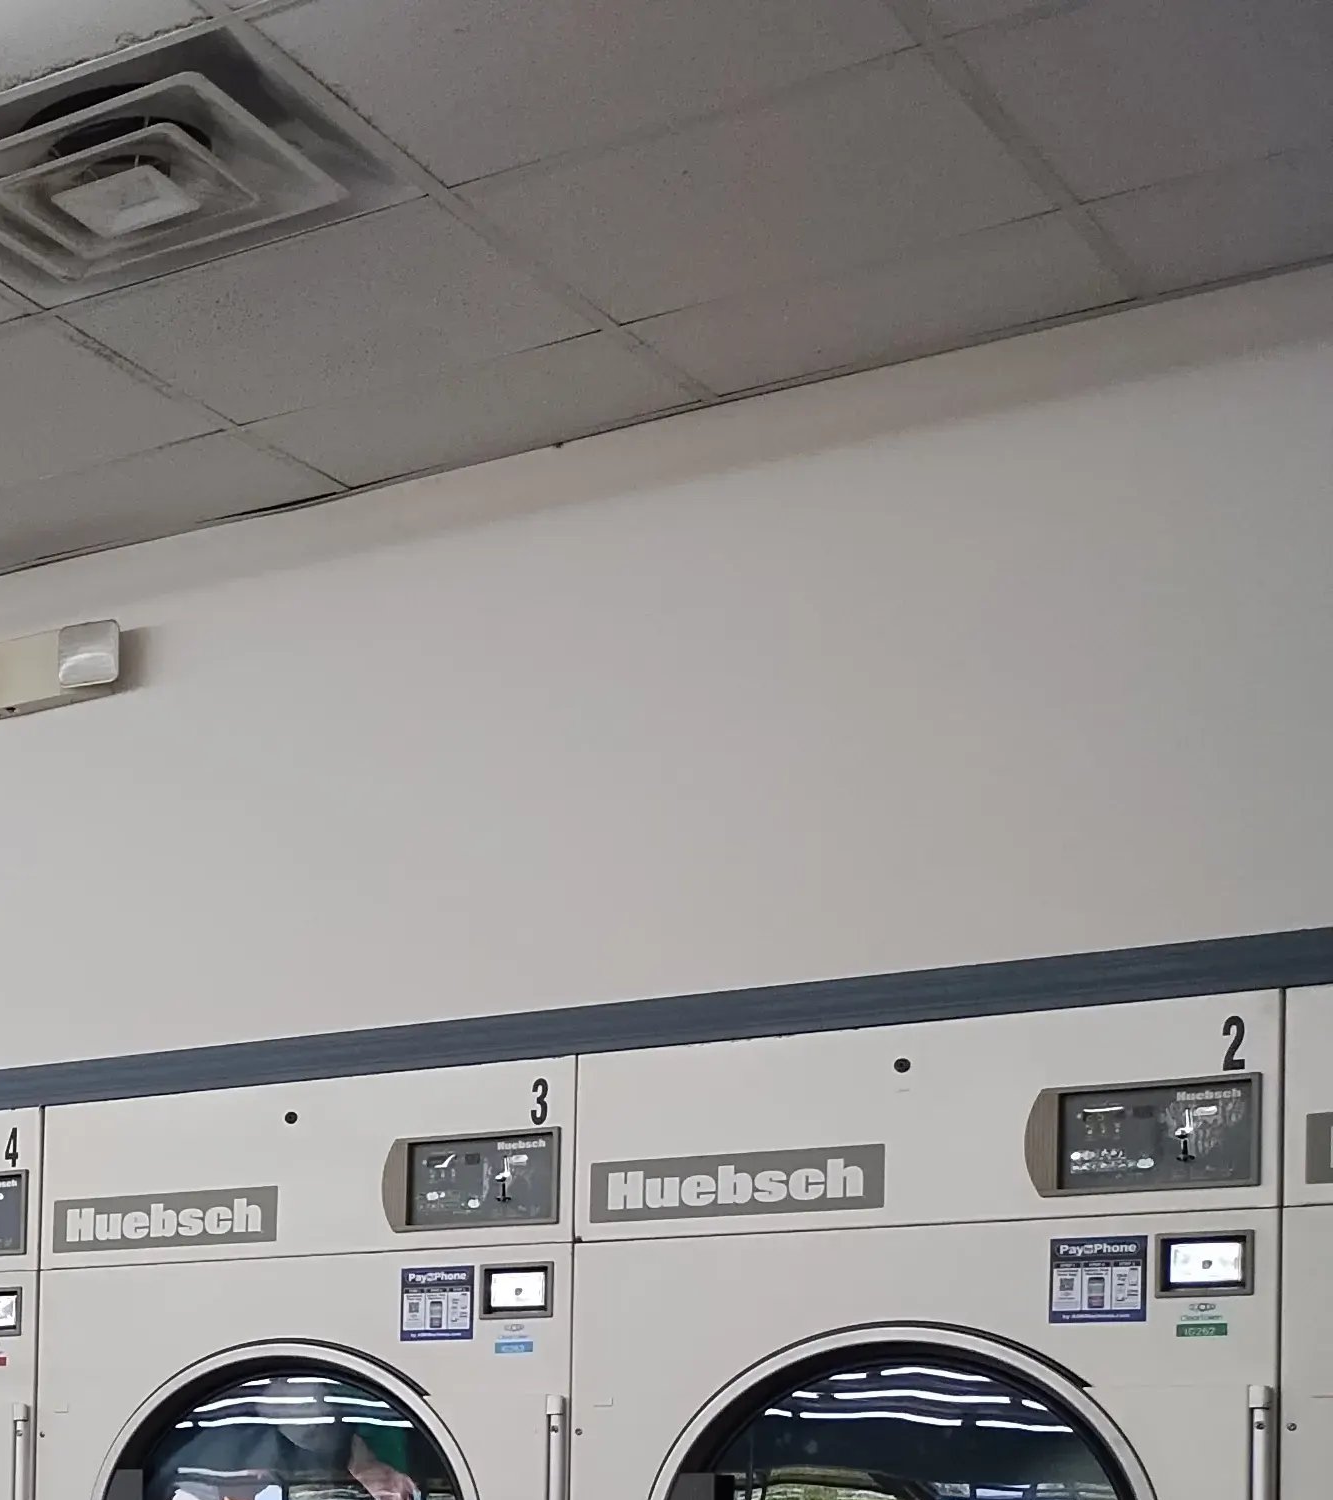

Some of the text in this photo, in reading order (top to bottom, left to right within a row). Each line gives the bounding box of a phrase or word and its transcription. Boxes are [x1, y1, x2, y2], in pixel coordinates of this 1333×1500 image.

[1222, 1015, 1245, 1071] 2
[530, 1077, 549, 1126] 3
[4, 1126, 19, 1168] 4
[606, 1158, 864, 1211] Huebsch
[66, 1197, 263, 1243] Huebsch
